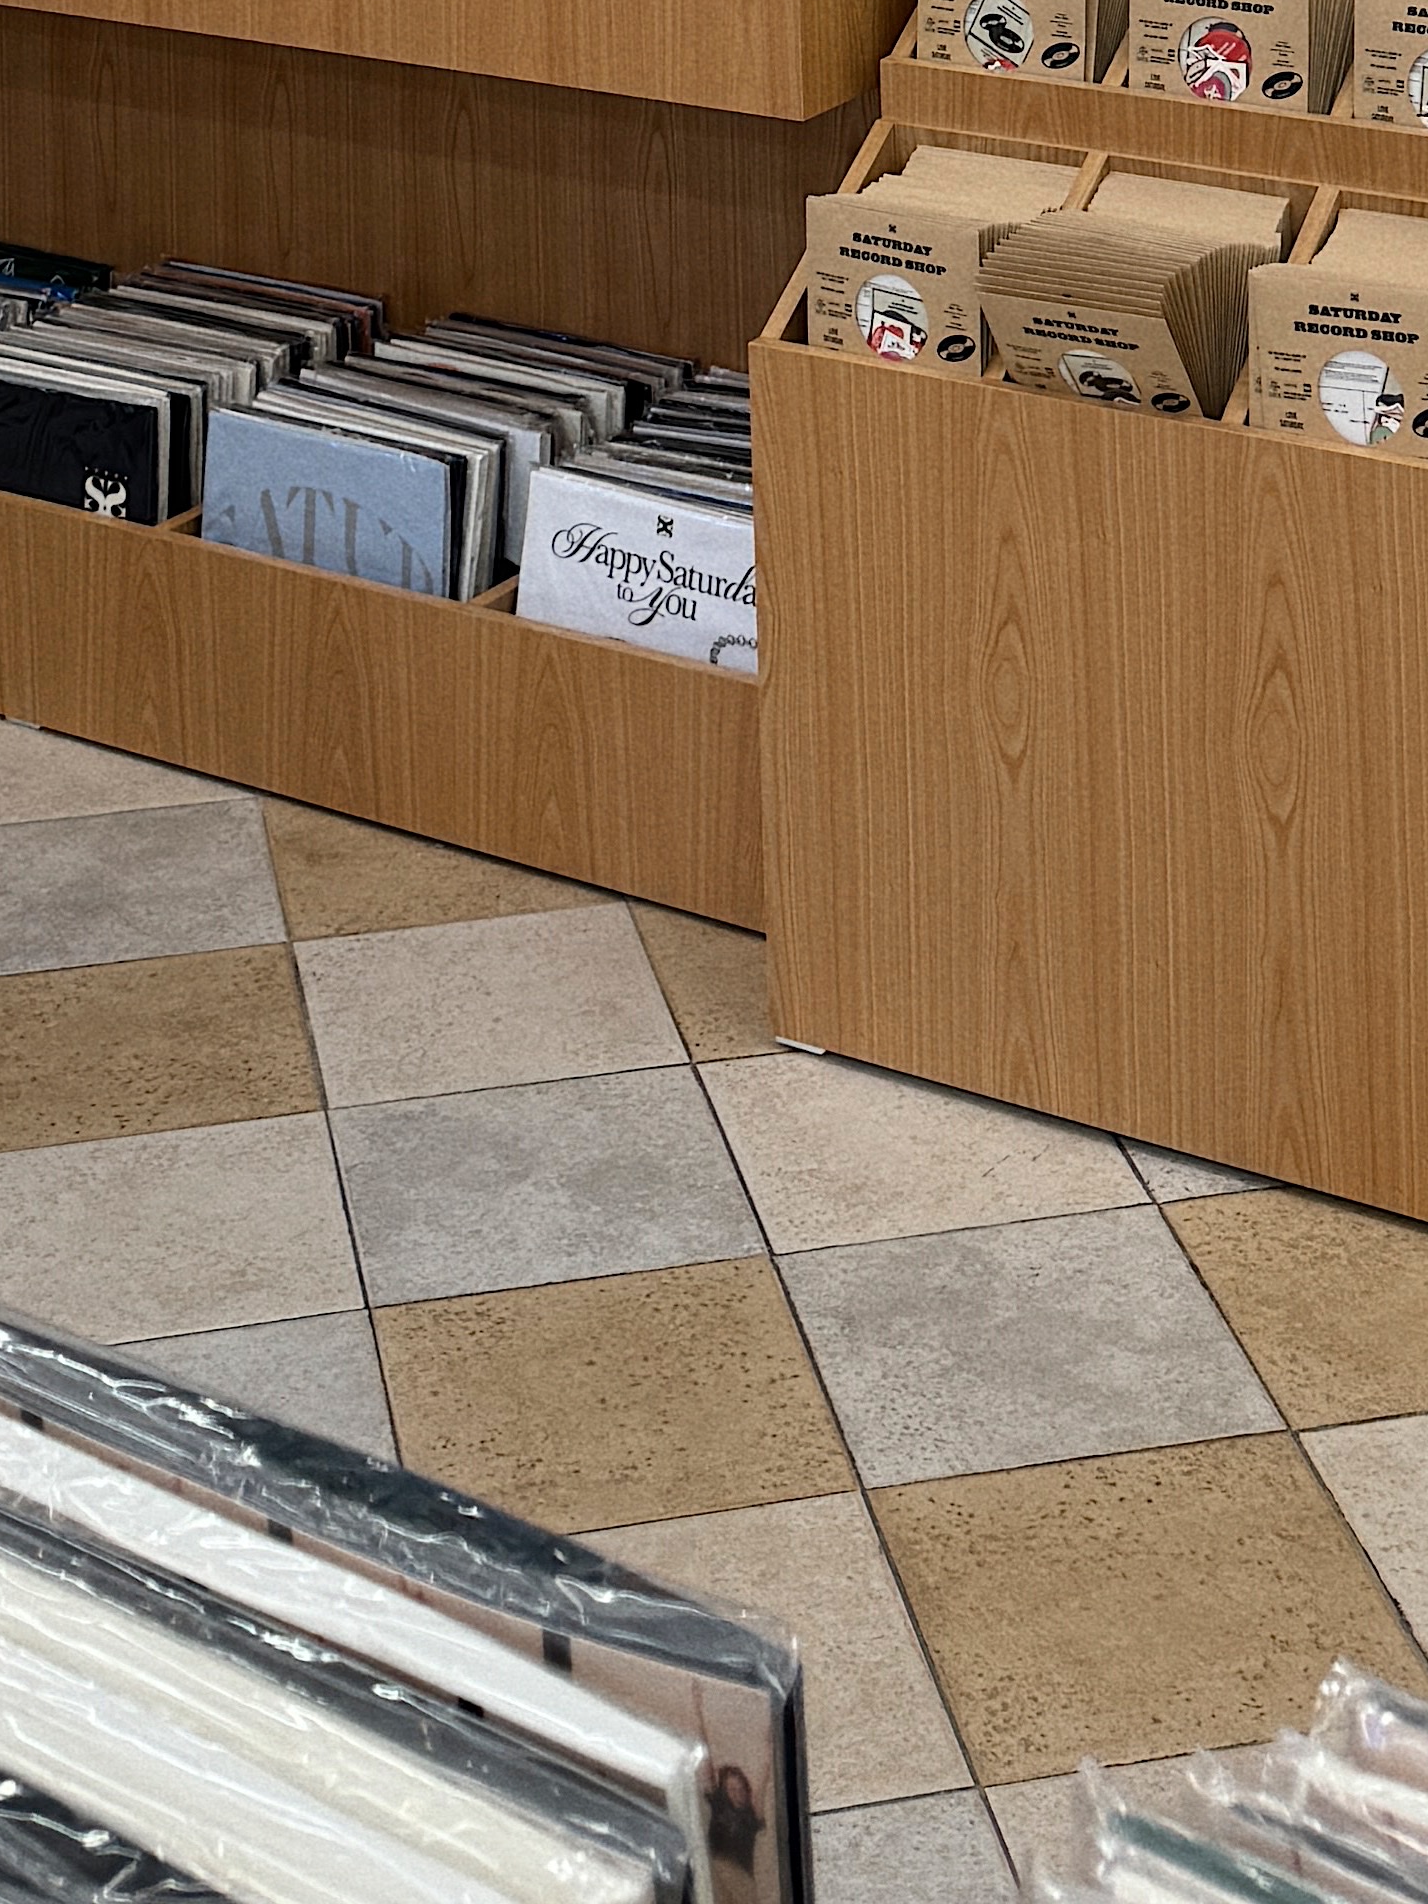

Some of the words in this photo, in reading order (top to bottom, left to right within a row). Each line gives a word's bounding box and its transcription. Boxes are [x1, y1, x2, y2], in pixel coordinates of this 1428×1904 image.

[1231, 0, 1275, 15] SHOP
[852, 232, 933, 257] SATURDAY
[839, 246, 904, 268] RECORD
[905, 260, 947, 276] SHOP
[1031, 316, 1119, 337] SATURDAY
[1308, 304, 1403, 325] SATURDAY
[1022, 326, 1092, 347] RECORD
[1095, 338, 1140, 351] SHOP
[1293, 321, 1369, 342] RECORD
[1371, 330, 1420, 345] SHOP
[551, 522, 658, 581] Happy
[617, 583, 633, 602] to
[628, 585, 698, 626] You
